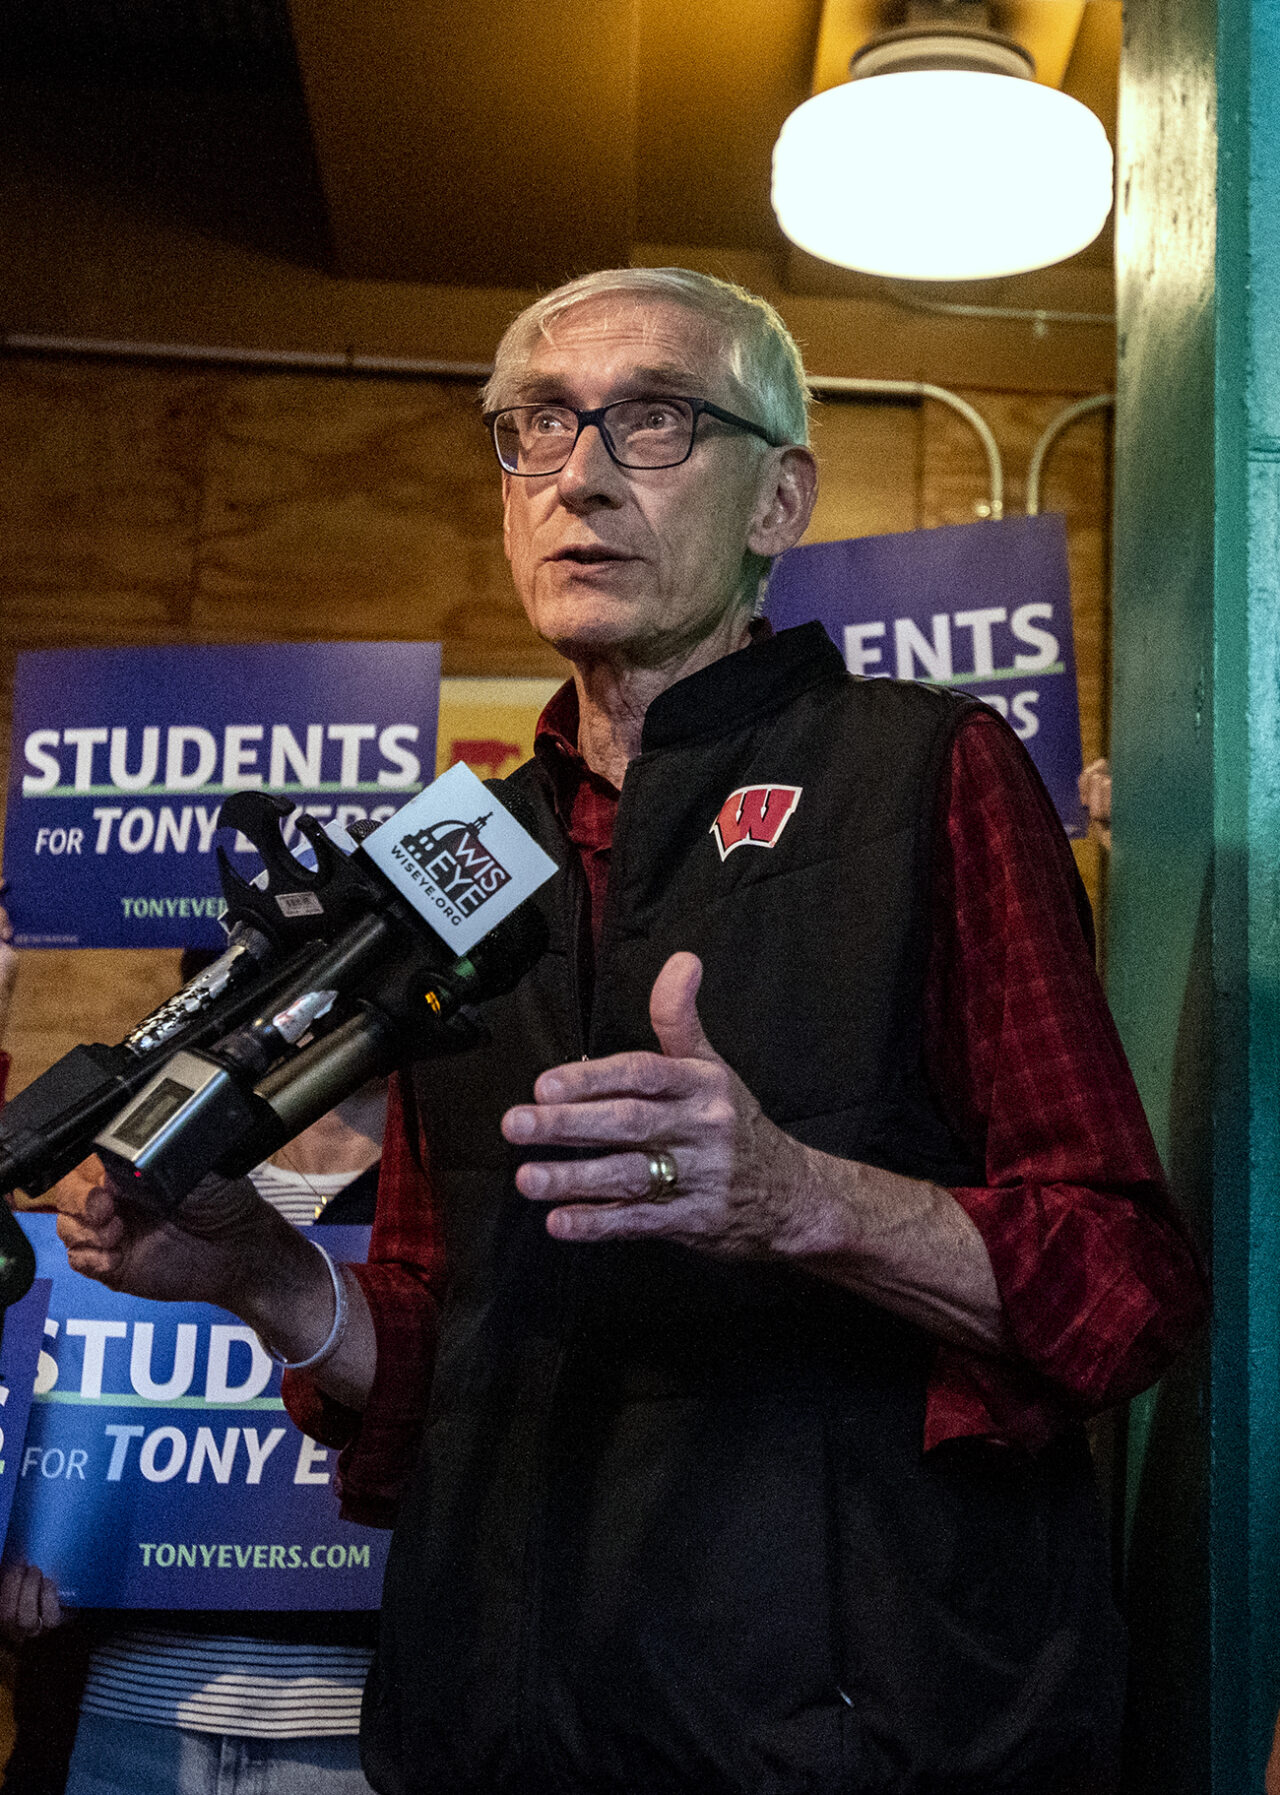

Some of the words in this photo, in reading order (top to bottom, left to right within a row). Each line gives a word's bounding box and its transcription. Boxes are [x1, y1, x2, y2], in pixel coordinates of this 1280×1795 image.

[844, 603, 1059, 681] ENTS
[23, 724, 420, 792] STUDENTS
[35, 828, 84, 856] FOR
[93, 807, 221, 856] TONY
[710, 784, 803, 861] W
[391, 845, 462, 926] WISEYE.ORG
[425, 850, 485, 915] EYE
[456, 832, 507, 892] WIS
[22, 1446, 88, 1480] FOR
[105, 1425, 286, 1485] TONY
[139, 1543, 370, 1569] TONYEVERS.COM
